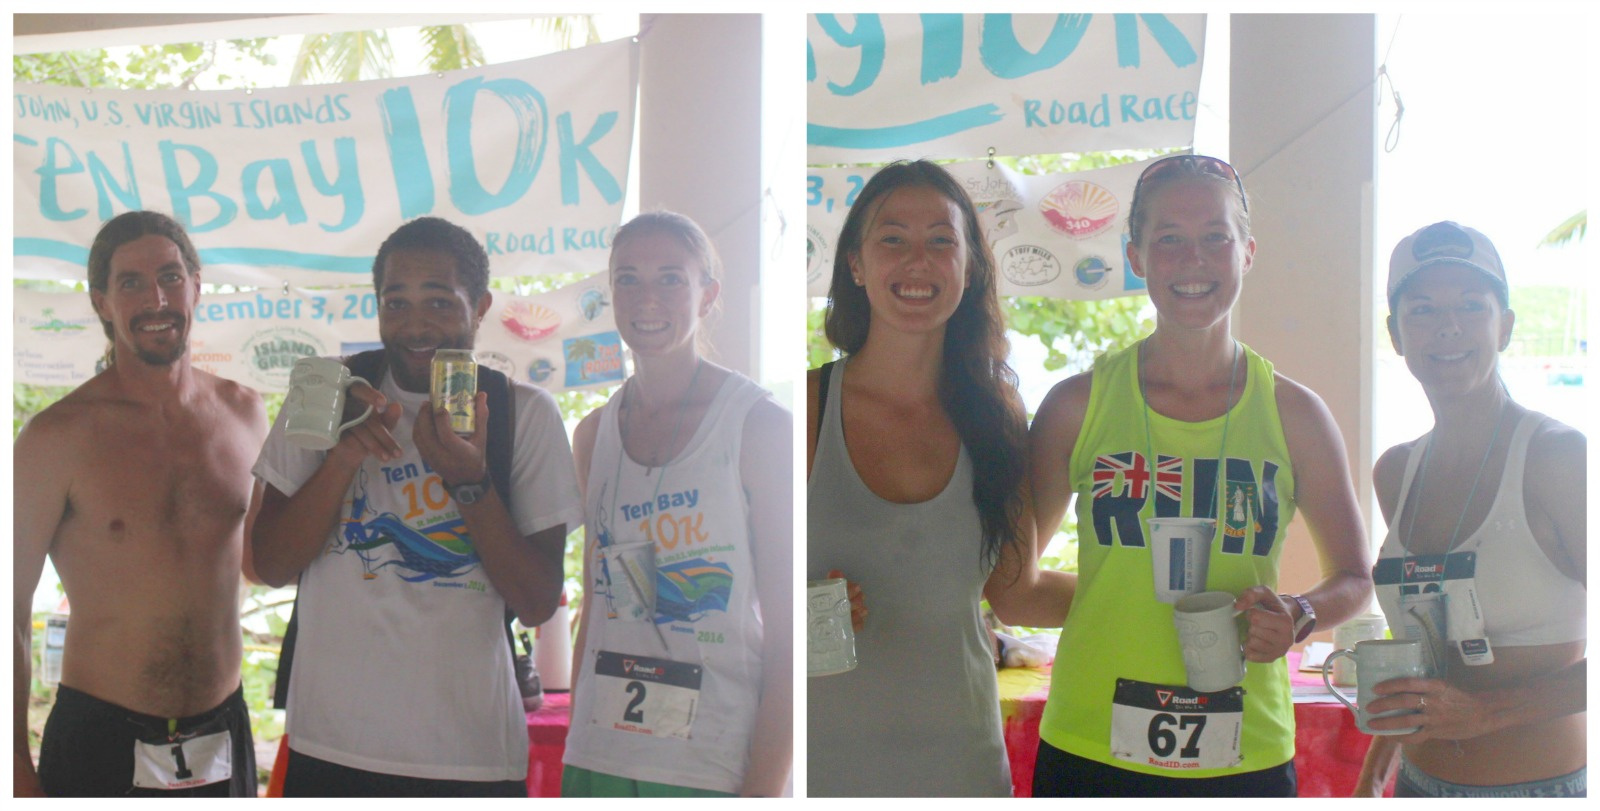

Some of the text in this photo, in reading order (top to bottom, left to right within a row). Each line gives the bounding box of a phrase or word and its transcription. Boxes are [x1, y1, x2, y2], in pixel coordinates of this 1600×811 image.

[1023, 90, 1197, 129] Road Race
[13, 75, 623, 233] eN Bay 10K
[1066, 219, 1091, 230] 340
[486, 226, 555, 256] Road
[310, 296, 333, 325] 3,
[253, 340, 318, 357] ISLAND
[586, 357, 621, 373] ROOM
[381, 463, 418, 484] Ten
[620, 488, 699, 522] Ten Bay
[1091, 451, 1280, 557] RUN
[639, 512, 710, 553] 10K
[697, 630, 725, 644] 2016
[623, 680, 647, 724] 2
[1147, 712, 1208, 758] 67
[171, 745, 193, 780] 1
[1148, 757, 1200, 769] RoadID.com
